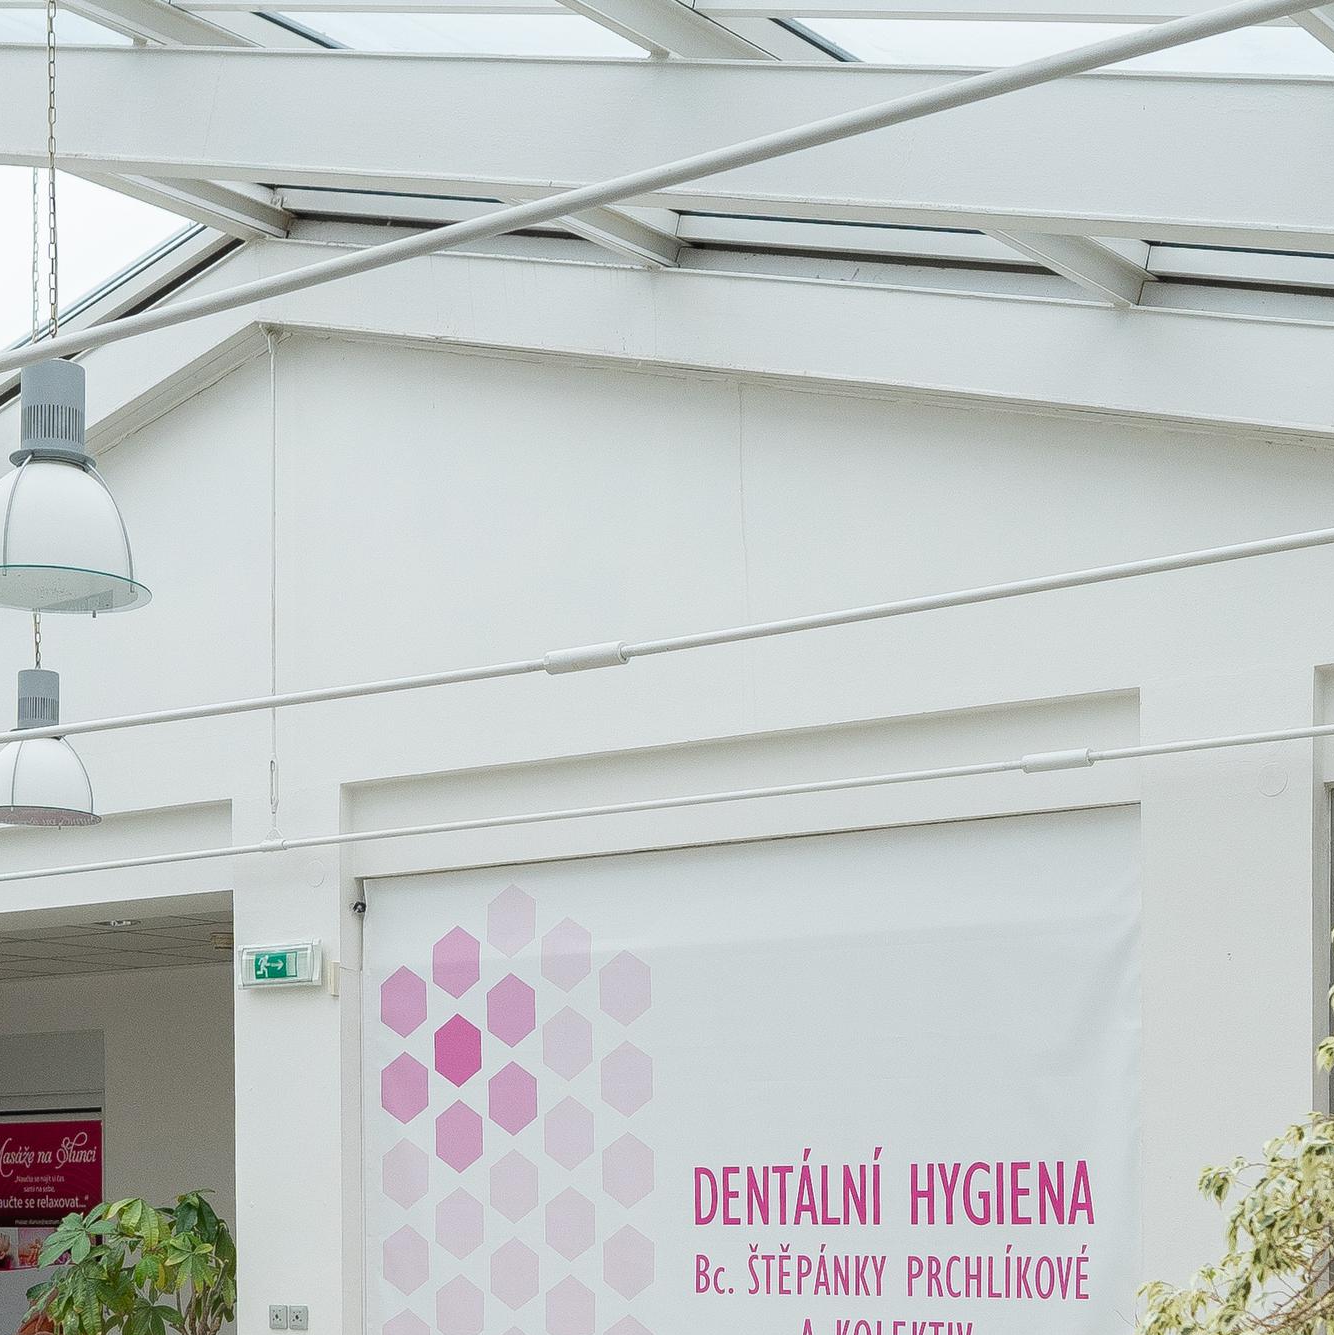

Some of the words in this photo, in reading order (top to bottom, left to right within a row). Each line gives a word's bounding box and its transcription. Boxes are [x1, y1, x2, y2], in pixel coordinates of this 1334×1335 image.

[37, 1151, 53, 1164] na
[55, 1132, 97, 1169] Slunci
[25, 1199, 36, 1209] se
[693, 1147, 883, 1226] DENTÁLNÍ
[910, 1160, 1095, 1226] HYGIENA
[695, 1254, 735, 1295] Bc.
[747, 1243, 887, 1297] ŠTĚPÁNKY
[907, 1244, 1090, 1300] PRCHLÍKOVÉ
